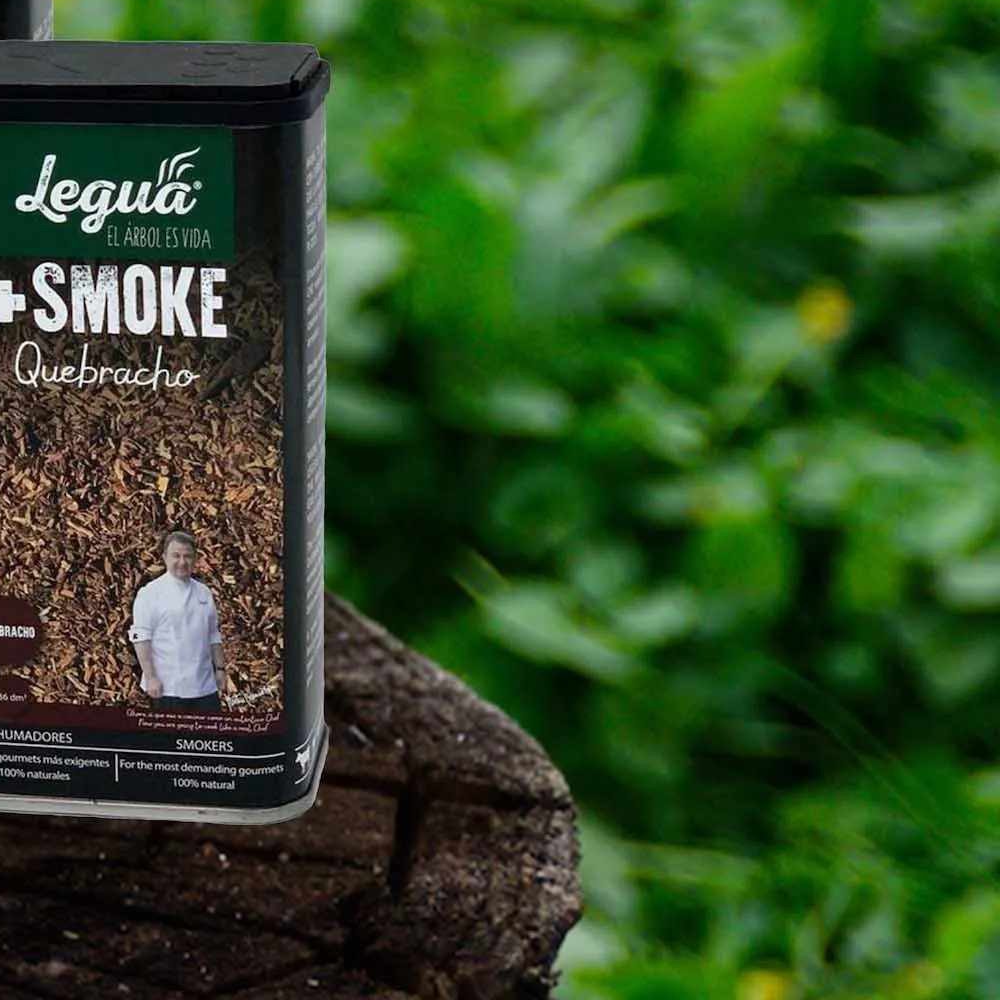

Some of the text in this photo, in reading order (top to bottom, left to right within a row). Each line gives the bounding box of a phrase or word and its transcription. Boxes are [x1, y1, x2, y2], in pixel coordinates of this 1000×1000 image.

[107, 221, 211, 249] EL ÁRBOL ES VIDA
[15, 341, 200, 391] Quebracho
[175, 739, 234, 752] SMOKERS
[63, 756, 110, 768] exigentes
[120, 759, 284, 777] For the most demanding gourmets
[0, 767, 71, 781] 100% naturales
[173, 778, 236, 790] 100% natural
